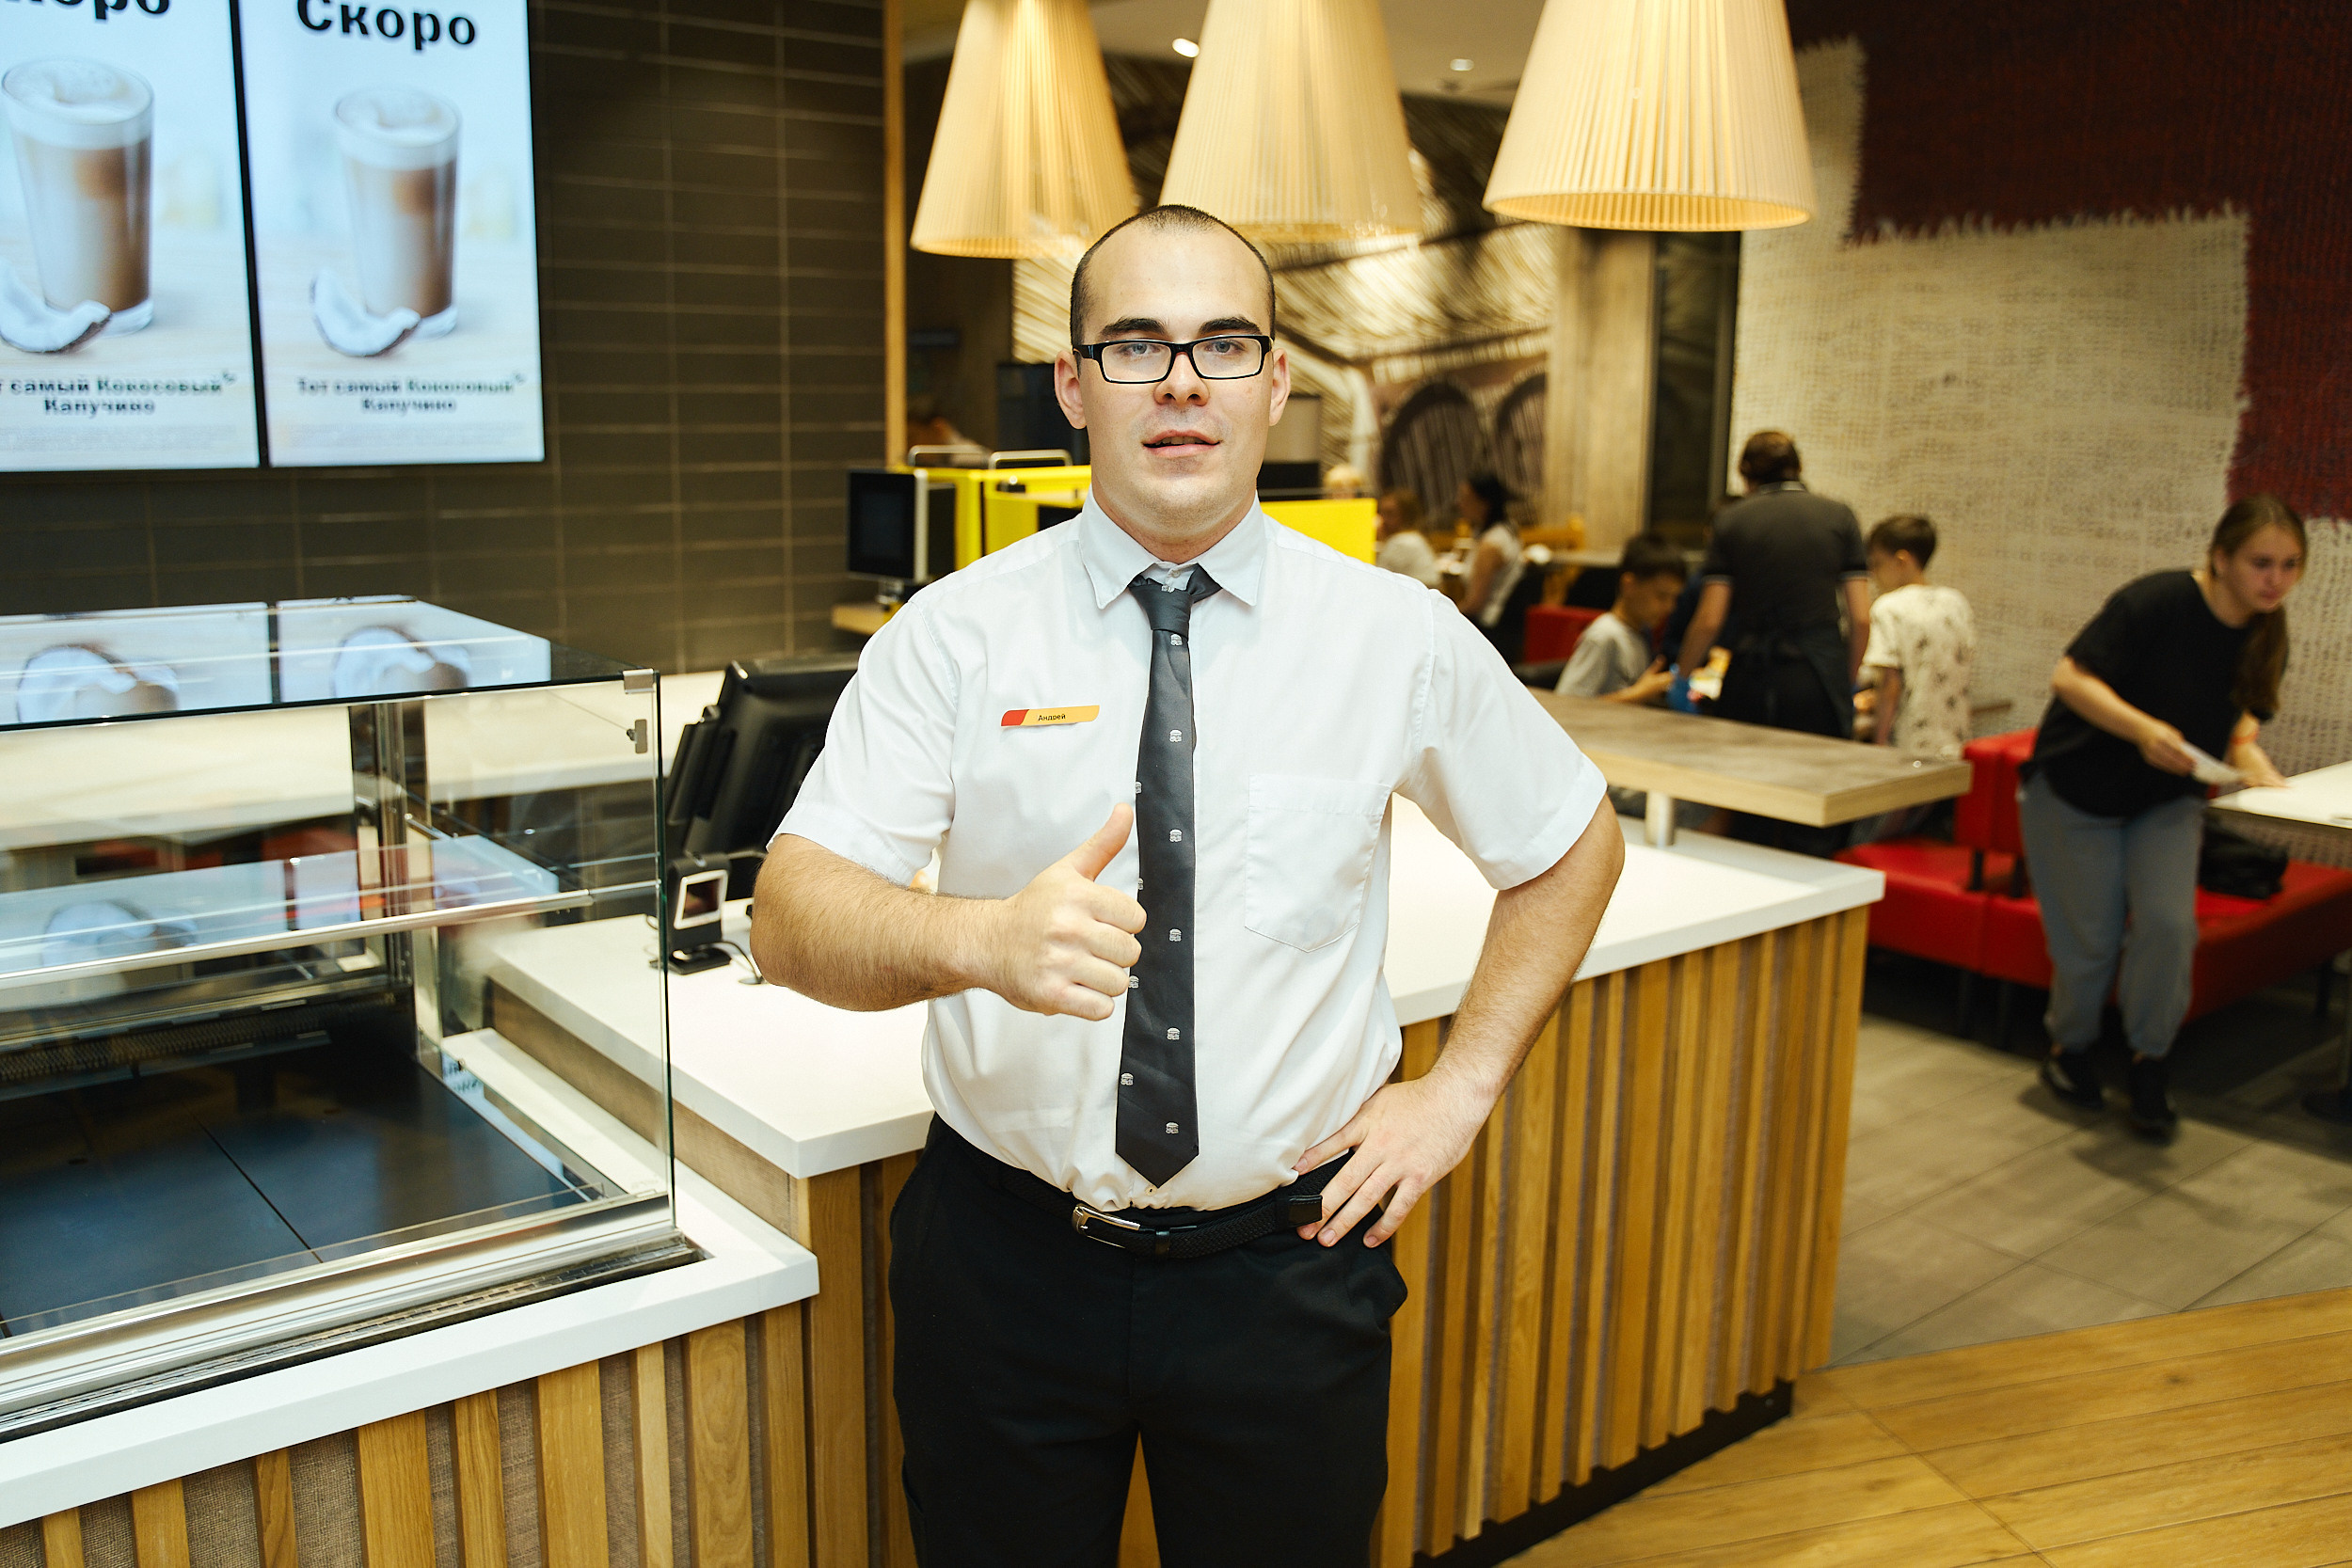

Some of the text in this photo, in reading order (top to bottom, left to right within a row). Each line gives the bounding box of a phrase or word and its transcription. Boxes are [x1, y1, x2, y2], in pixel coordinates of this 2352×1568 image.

[296, 0, 476, 51] Скоро
[10, 376, 91, 394] самый
[43, 399, 156, 417] Капучино
[1038, 713, 1066, 721] Андрей
